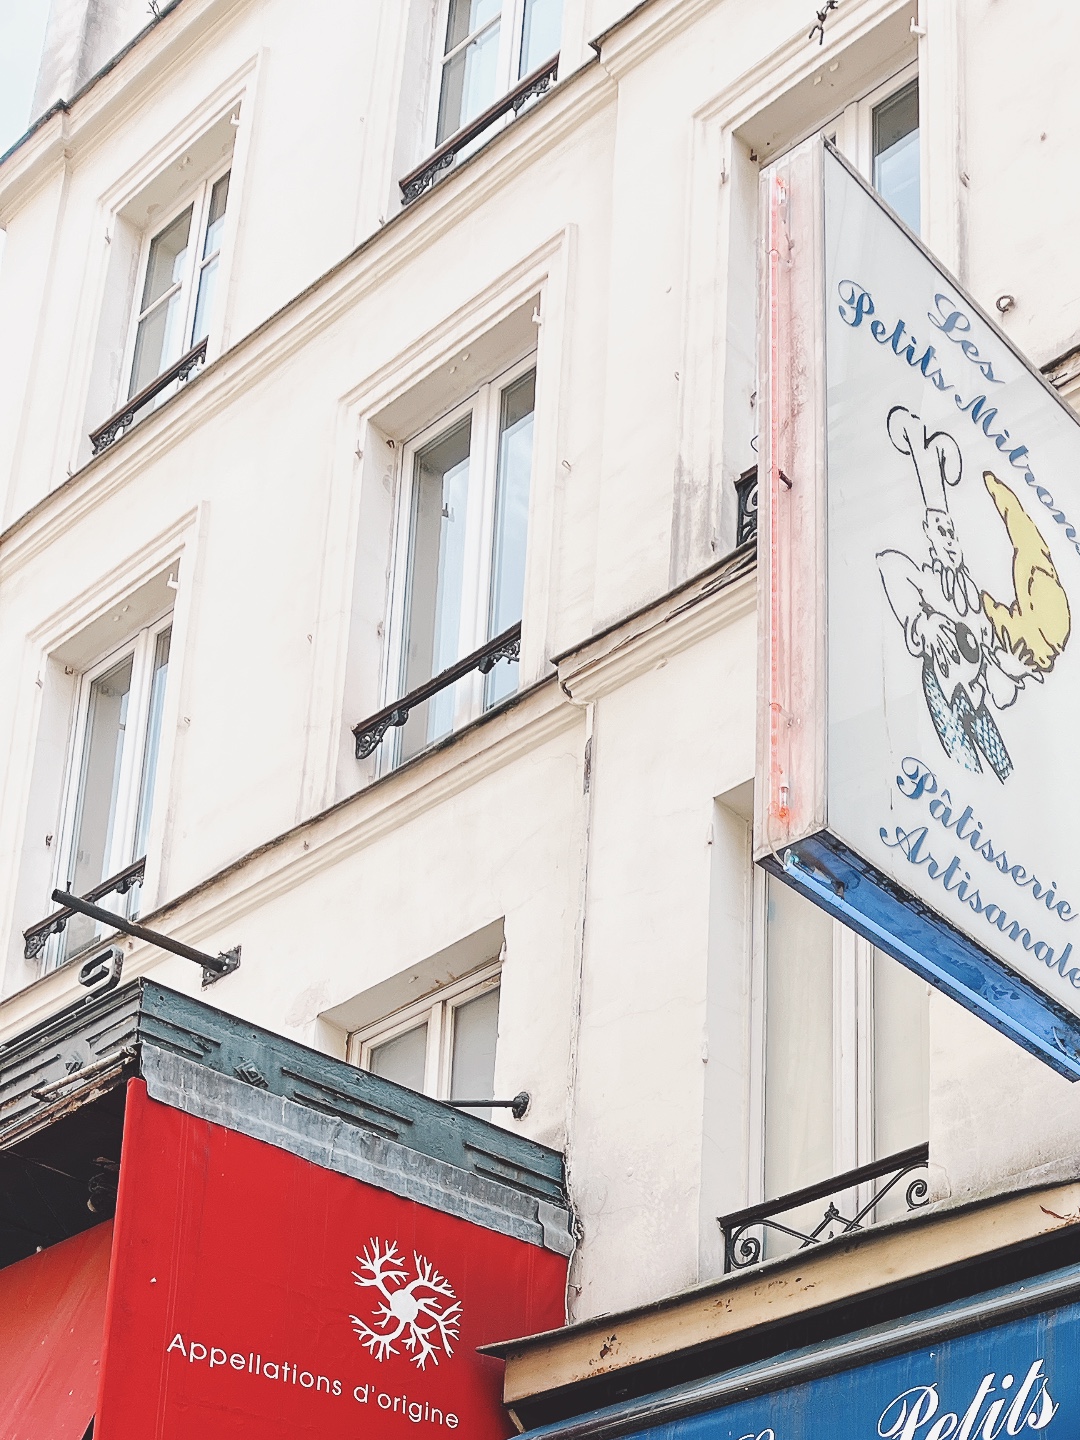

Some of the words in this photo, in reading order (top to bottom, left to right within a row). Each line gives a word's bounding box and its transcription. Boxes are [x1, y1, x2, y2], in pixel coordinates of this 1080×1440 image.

[837, 279, 956, 392] Petits
[927, 293, 1006, 384] Les
[896, 756, 1079, 922] Pâtisserie
[166, 1332, 343, 1397] Appellations
[353, 1385, 460, 1429] d'origine
